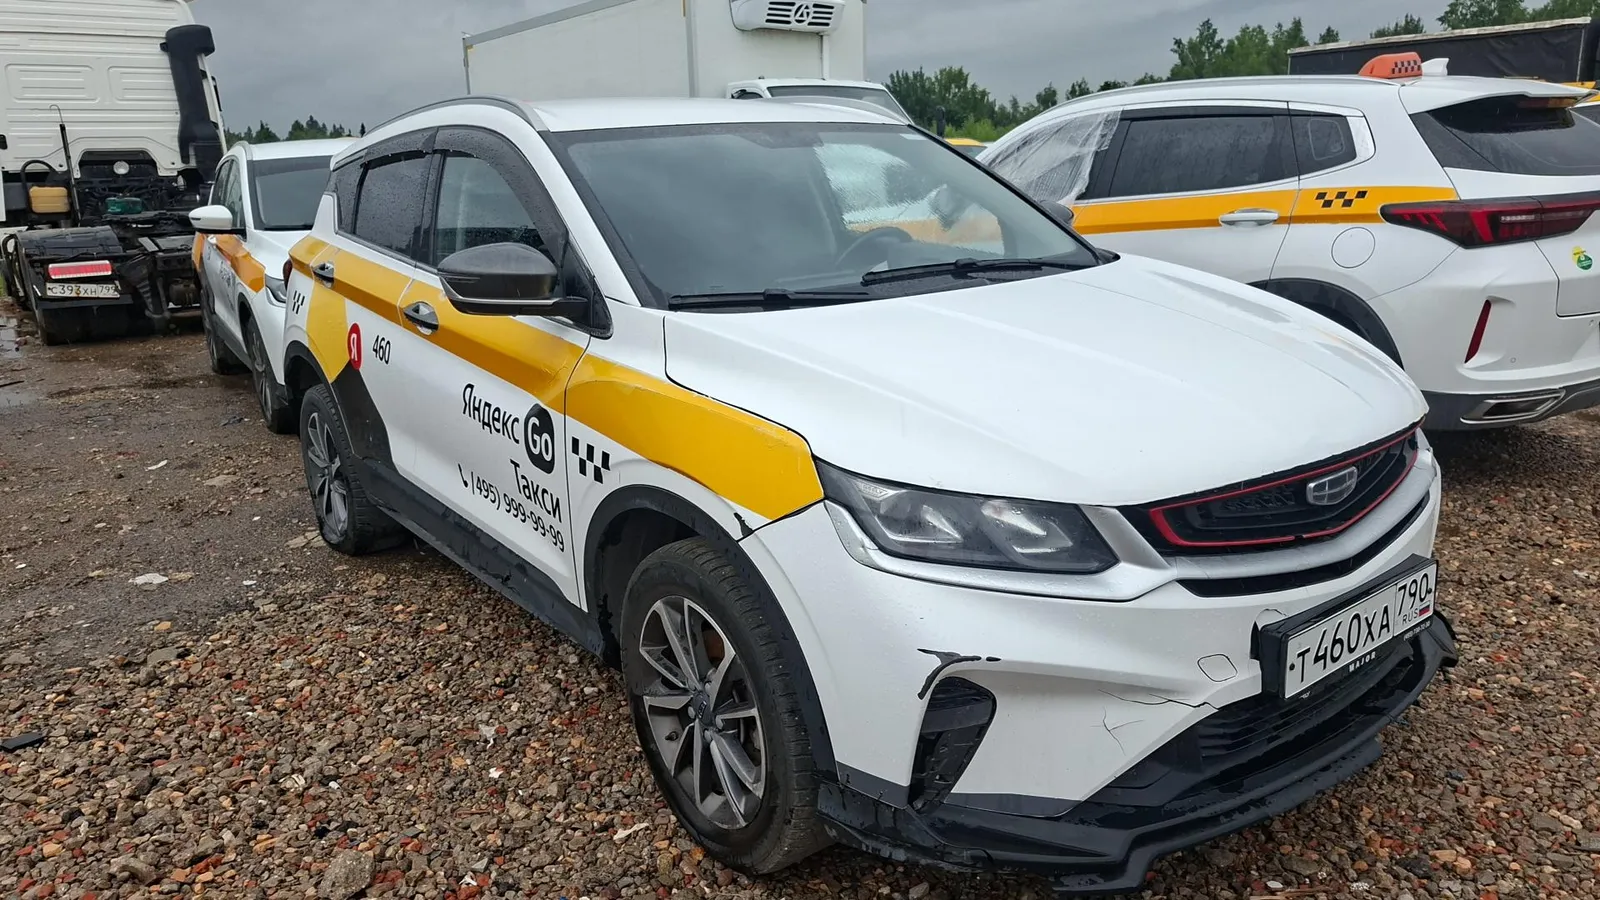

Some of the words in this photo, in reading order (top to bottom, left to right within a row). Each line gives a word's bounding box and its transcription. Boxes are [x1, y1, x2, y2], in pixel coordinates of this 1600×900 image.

[350, 333, 358, 361] Я
[372, 334, 391, 365] 460
[462, 383, 520, 445] Яндекс
[527, 416, 553, 462] Go
[470, 471, 500, 510] (495)
[503, 493, 565, 553] 999-99-99
[509, 458, 562, 523] Такси
[1297, 604, 1390, 683] Т460ХА
[1398, 572, 1431, 616] 790
[1402, 607, 1419, 624] RUS
[1350, 651, 1376, 672] MAJOR
